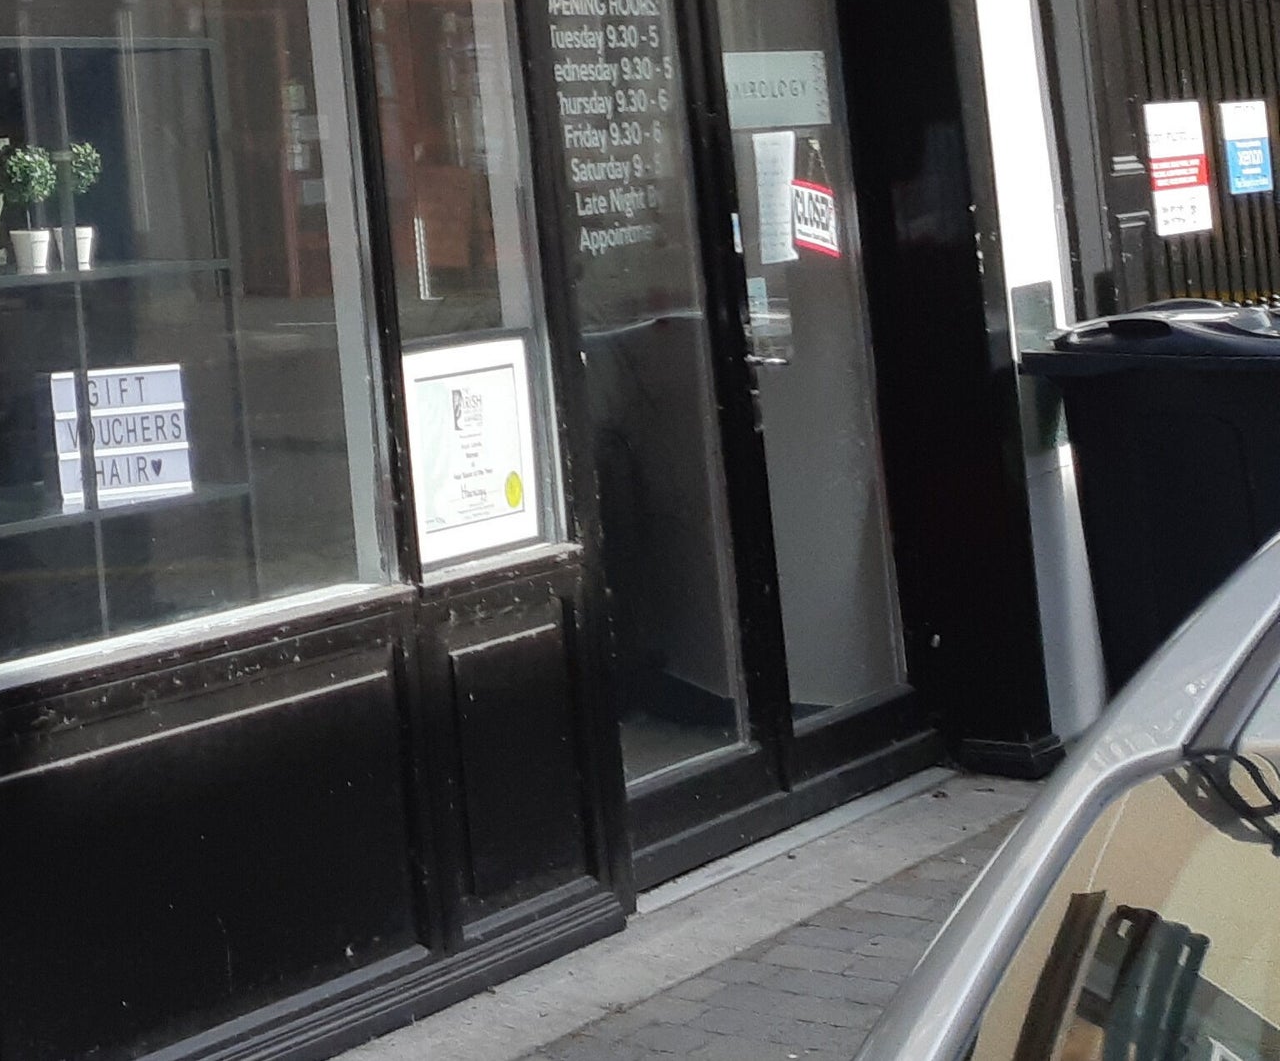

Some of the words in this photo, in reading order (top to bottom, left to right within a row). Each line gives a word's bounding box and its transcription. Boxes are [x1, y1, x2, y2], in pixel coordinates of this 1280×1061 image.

[549, 24, 604, 55] Tuesday
[606, 24, 639, 49] 9.30
[648, 24, 659, 48] 5
[620, 56, 652, 81] 9.30
[615, 88, 648, 113] 9.30
[563, 122, 608, 154] Friday
[609, 121, 643, 146] 9.30
[571, 155, 631, 185] Saturday
[575, 191, 608, 216] Late
[86, 375, 146, 407] GIFT
